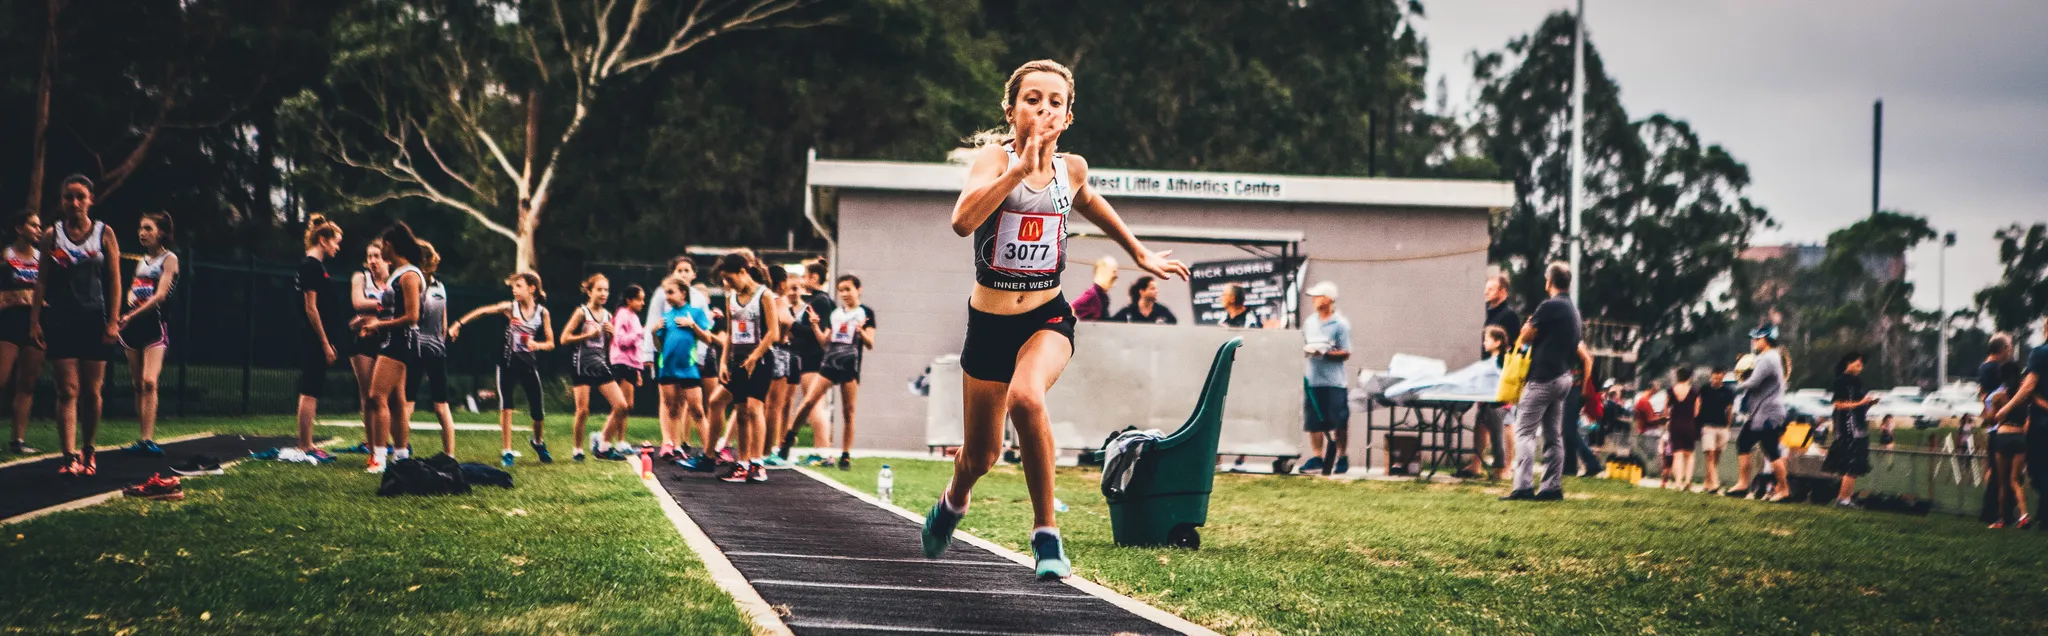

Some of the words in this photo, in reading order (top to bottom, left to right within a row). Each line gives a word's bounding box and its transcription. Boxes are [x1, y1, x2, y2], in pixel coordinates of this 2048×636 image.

[1088, 176, 1120, 189] West
[1125, 176, 1160, 192] Little
[1166, 177, 1229, 195] Athletics
[1234, 180, 1281, 197] Centre
[1057, 195, 1070, 210] 11
[1004, 242, 1050, 261] 3077
[1193, 266, 1223, 280] RICK
[1225, 261, 1273, 276] MORRIS
[993, 280, 1026, 290] INNER
[1028, 279, 1054, 289] WEST
